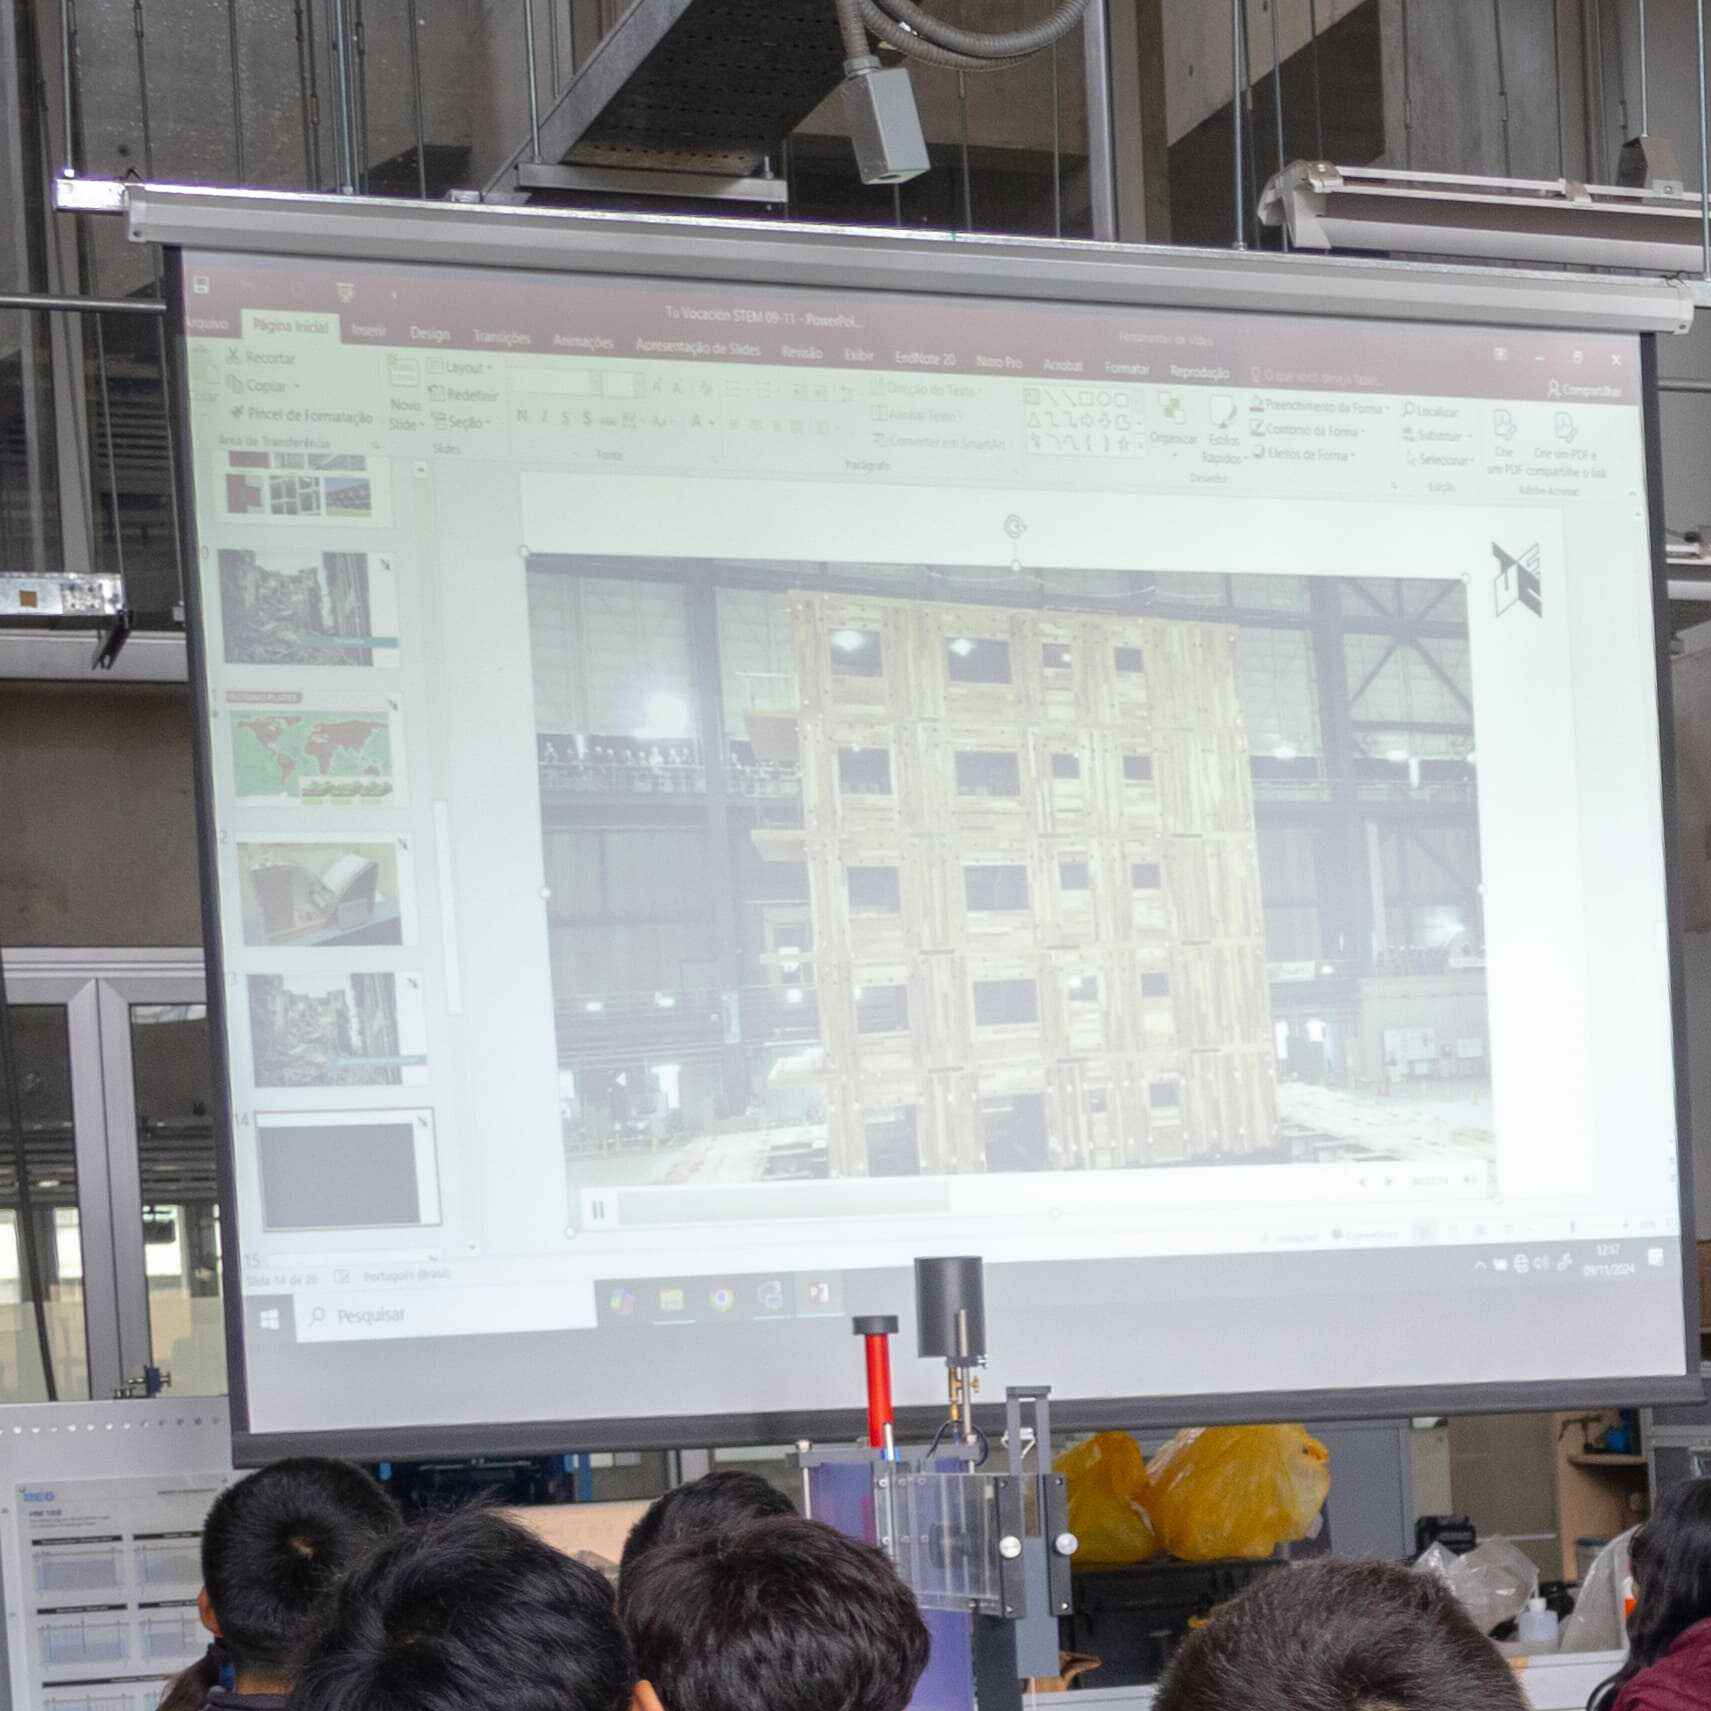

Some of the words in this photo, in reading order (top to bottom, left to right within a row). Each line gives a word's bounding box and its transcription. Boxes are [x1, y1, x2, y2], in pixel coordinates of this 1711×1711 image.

[733, 311, 763, 325] STEM
[253, 316, 296, 335] Página
[408, 324, 451, 343] Design
[473, 326, 533, 347] Transições
[552, 332, 615, 351] Animações
[246, 350, 296, 366] Recortar
[446, 360, 484, 377] Layout
[246, 377, 287, 395] Copiar
[390, 398, 421, 412] Novo
[249, 406, 285, 423] Pincel
[287, 407, 302, 422] de
[389, 418, 418, 432] Slide
[448, 415, 483, 433] Seção
[337, 1305, 406, 1325] Pesquisar
